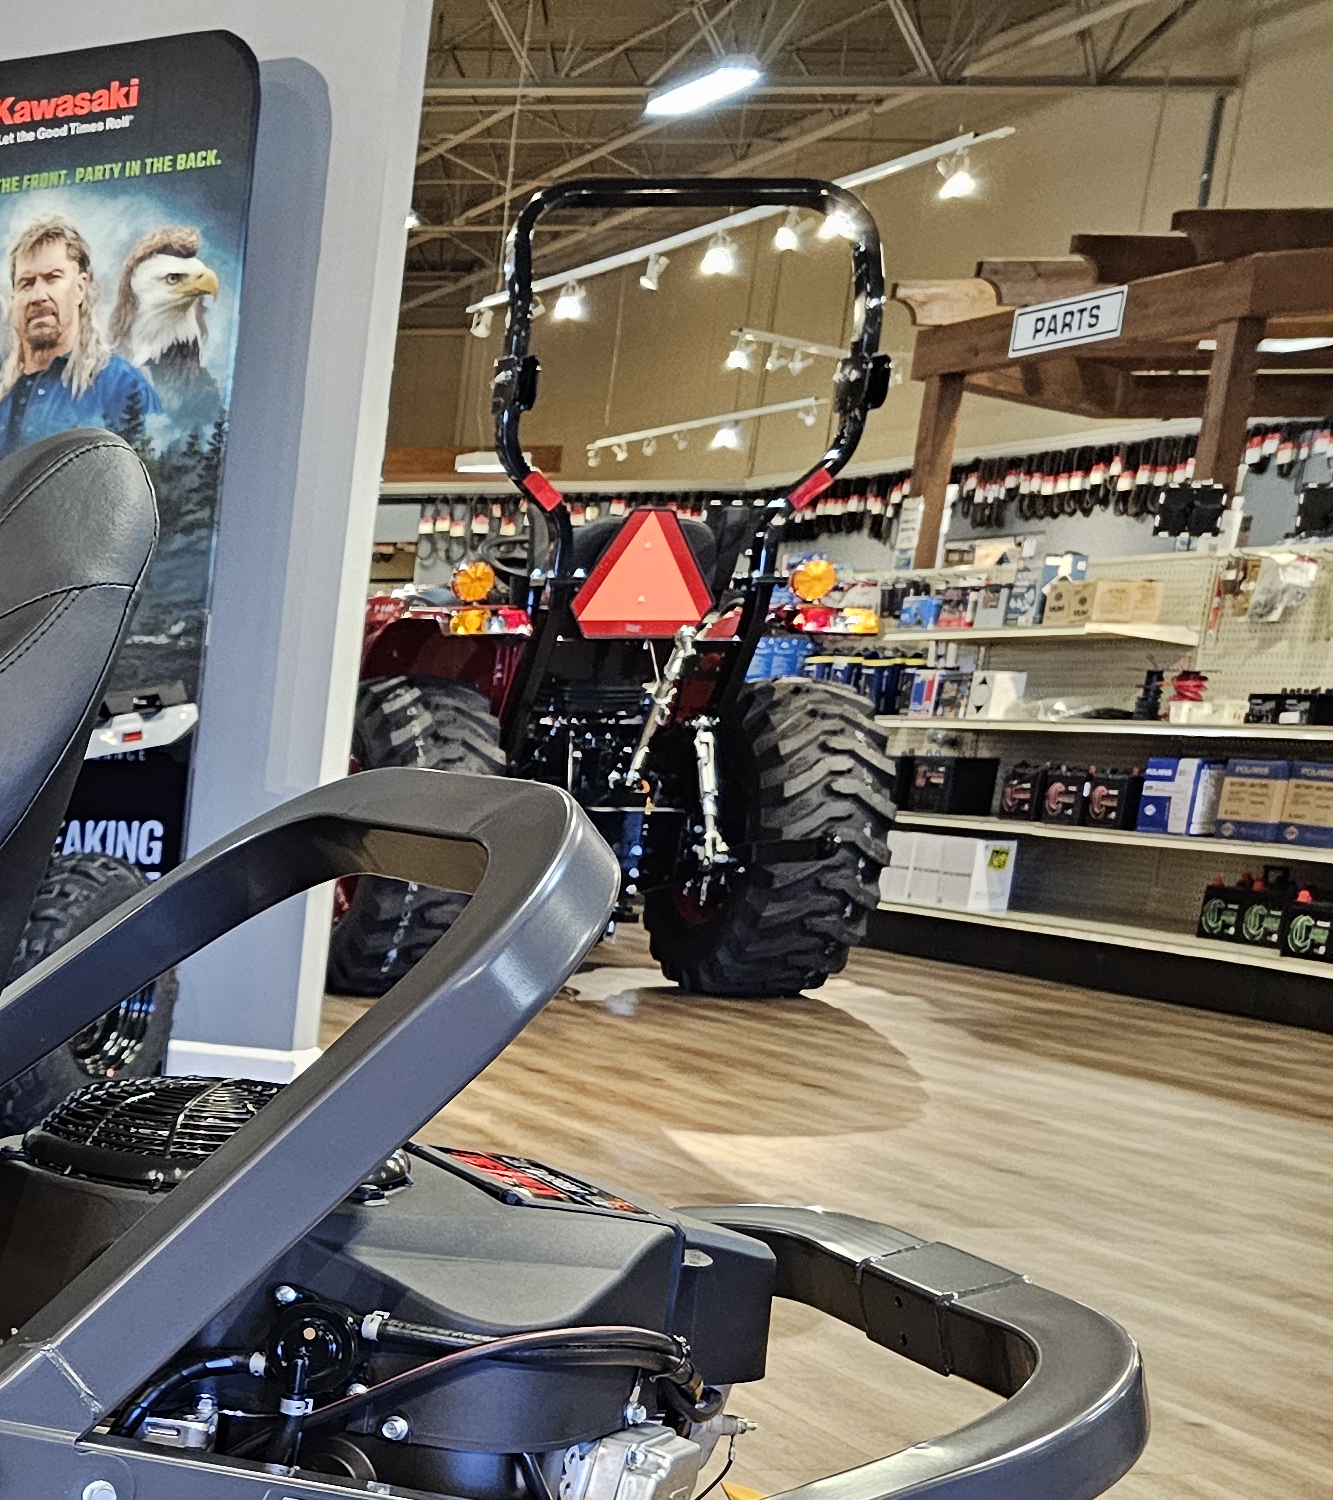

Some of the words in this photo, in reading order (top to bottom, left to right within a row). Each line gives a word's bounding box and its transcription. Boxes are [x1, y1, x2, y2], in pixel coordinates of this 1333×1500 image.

[17, 127, 35, 143] the
[37, 123, 68, 141] Good
[70, 118, 104, 135] Times
[22, 169, 71, 191] FRONT.
[75, 161, 122, 184] PARTY
[125, 158, 142, 177] IN
[145, 153, 173, 175] THE
[176, 148, 222, 171] BACK.
[1032, 304, 1101, 341] PARTS
[55, 819, 164, 865] AKING
